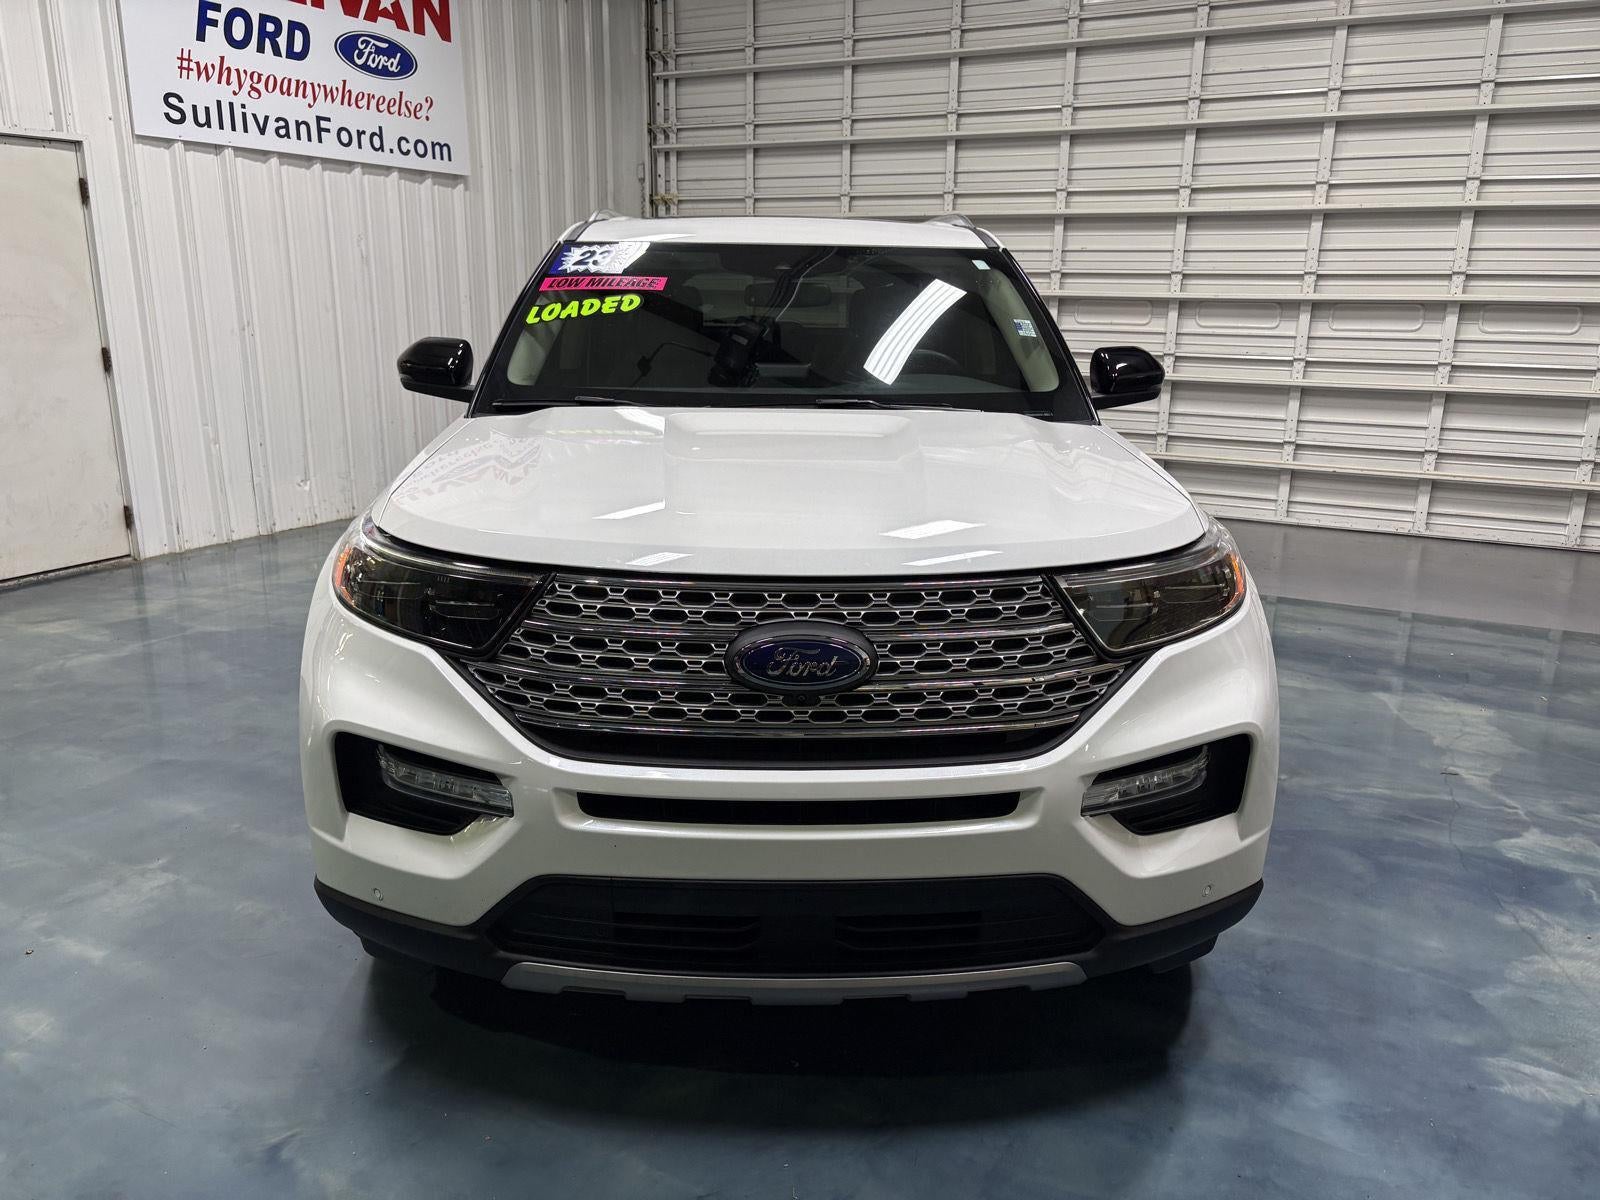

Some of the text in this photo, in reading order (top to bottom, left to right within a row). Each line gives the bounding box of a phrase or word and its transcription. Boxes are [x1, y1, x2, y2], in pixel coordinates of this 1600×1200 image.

[195, 0, 311, 61] FORD
[353, 36, 402, 74] Ford
[176, 48, 434, 121] #whygoanywhereelse?
[162, 92, 453, 162] SullivanFord.com
[548, 278, 659, 289] LOW MILEAGE
[525, 294, 642, 325] LOADED
[766, 647, 840, 677] Ford
